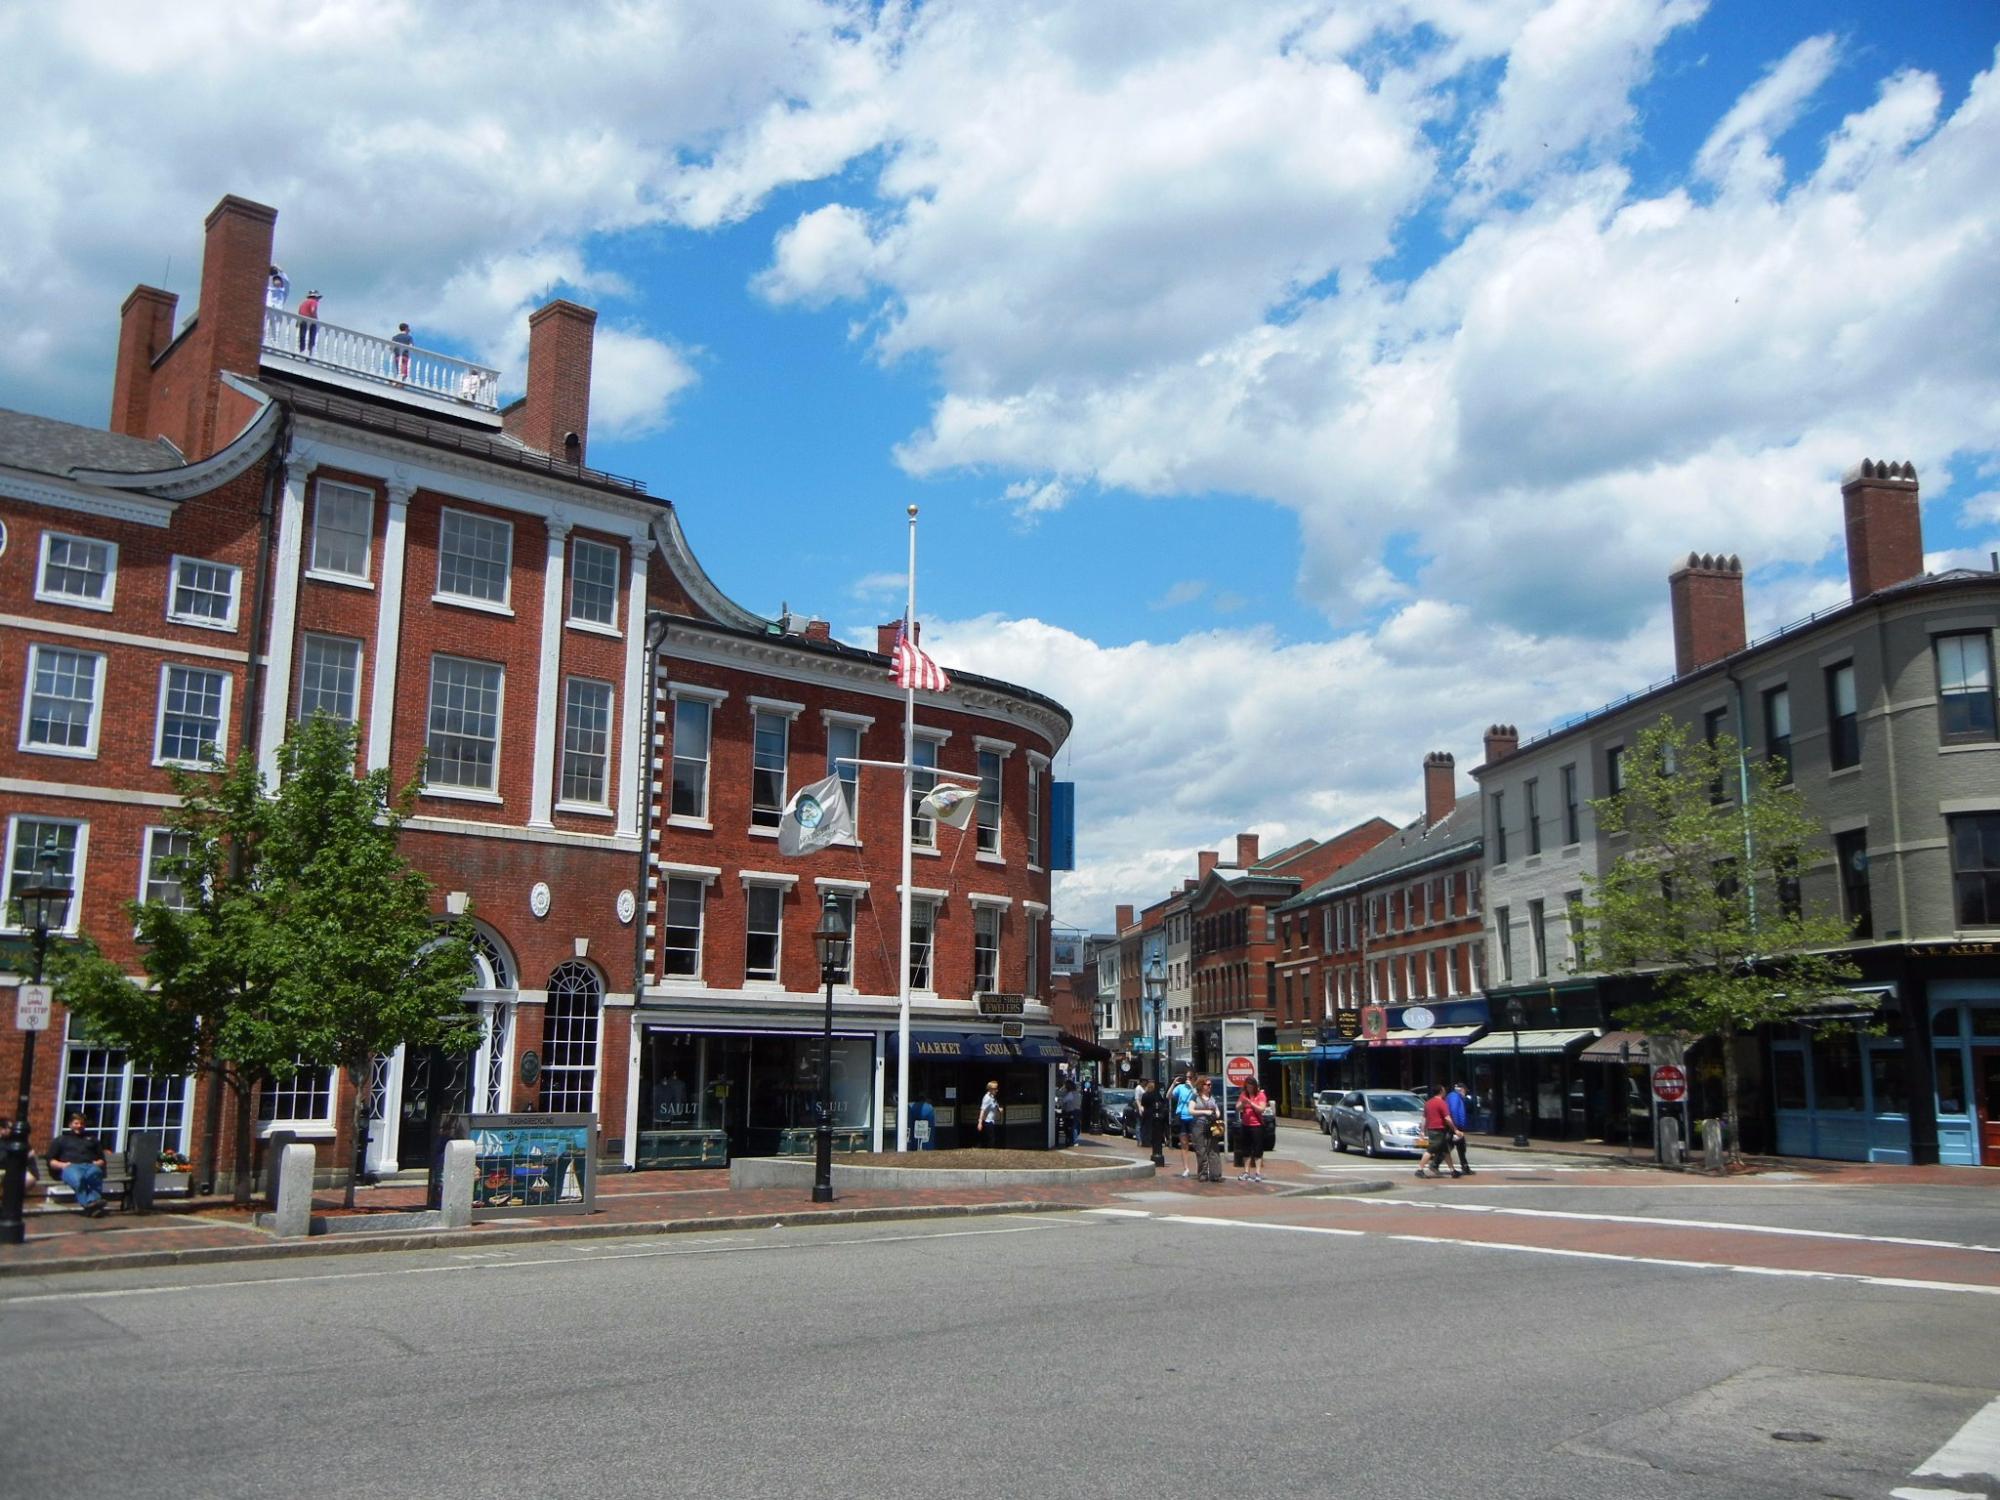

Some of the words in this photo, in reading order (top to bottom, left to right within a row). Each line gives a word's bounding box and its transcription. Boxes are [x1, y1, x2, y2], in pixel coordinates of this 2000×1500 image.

[34, 1006, 48, 1014] STOP
[983, 1003, 1021, 1013] JEWELERS
[916, 1041, 961, 1055] MARKET
[660, 1102, 699, 1115] SAULT
[815, 1101, 849, 1113] SULT
